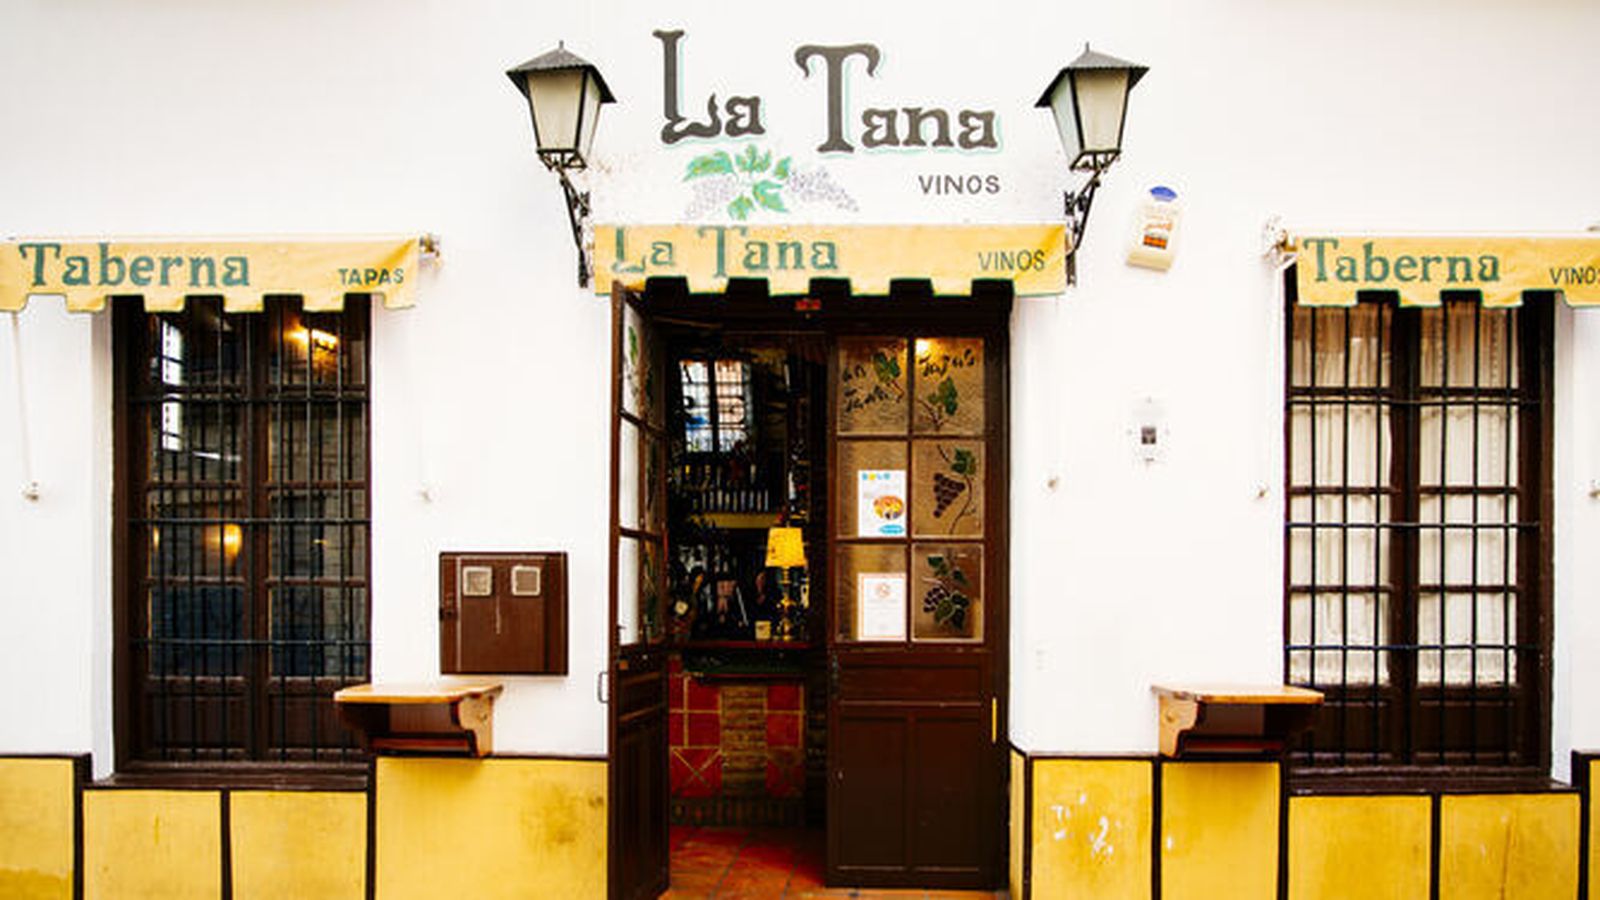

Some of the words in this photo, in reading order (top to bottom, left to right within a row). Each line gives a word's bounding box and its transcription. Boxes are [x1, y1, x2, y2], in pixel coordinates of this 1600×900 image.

[652, 29, 766, 145] La
[794, 44, 998, 153] Tana
[917, 174, 1001, 196] VINOS
[19, 242, 250, 288] Taberna
[338, 267, 404, 286] TAPAS
[611, 226, 674, 273] La
[697, 225, 838, 279] Tana
[978, 249, 1046, 272] VINOS
[1301, 237, 1501, 284] Taberna
[1549, 266, 1600, 285] VINO
